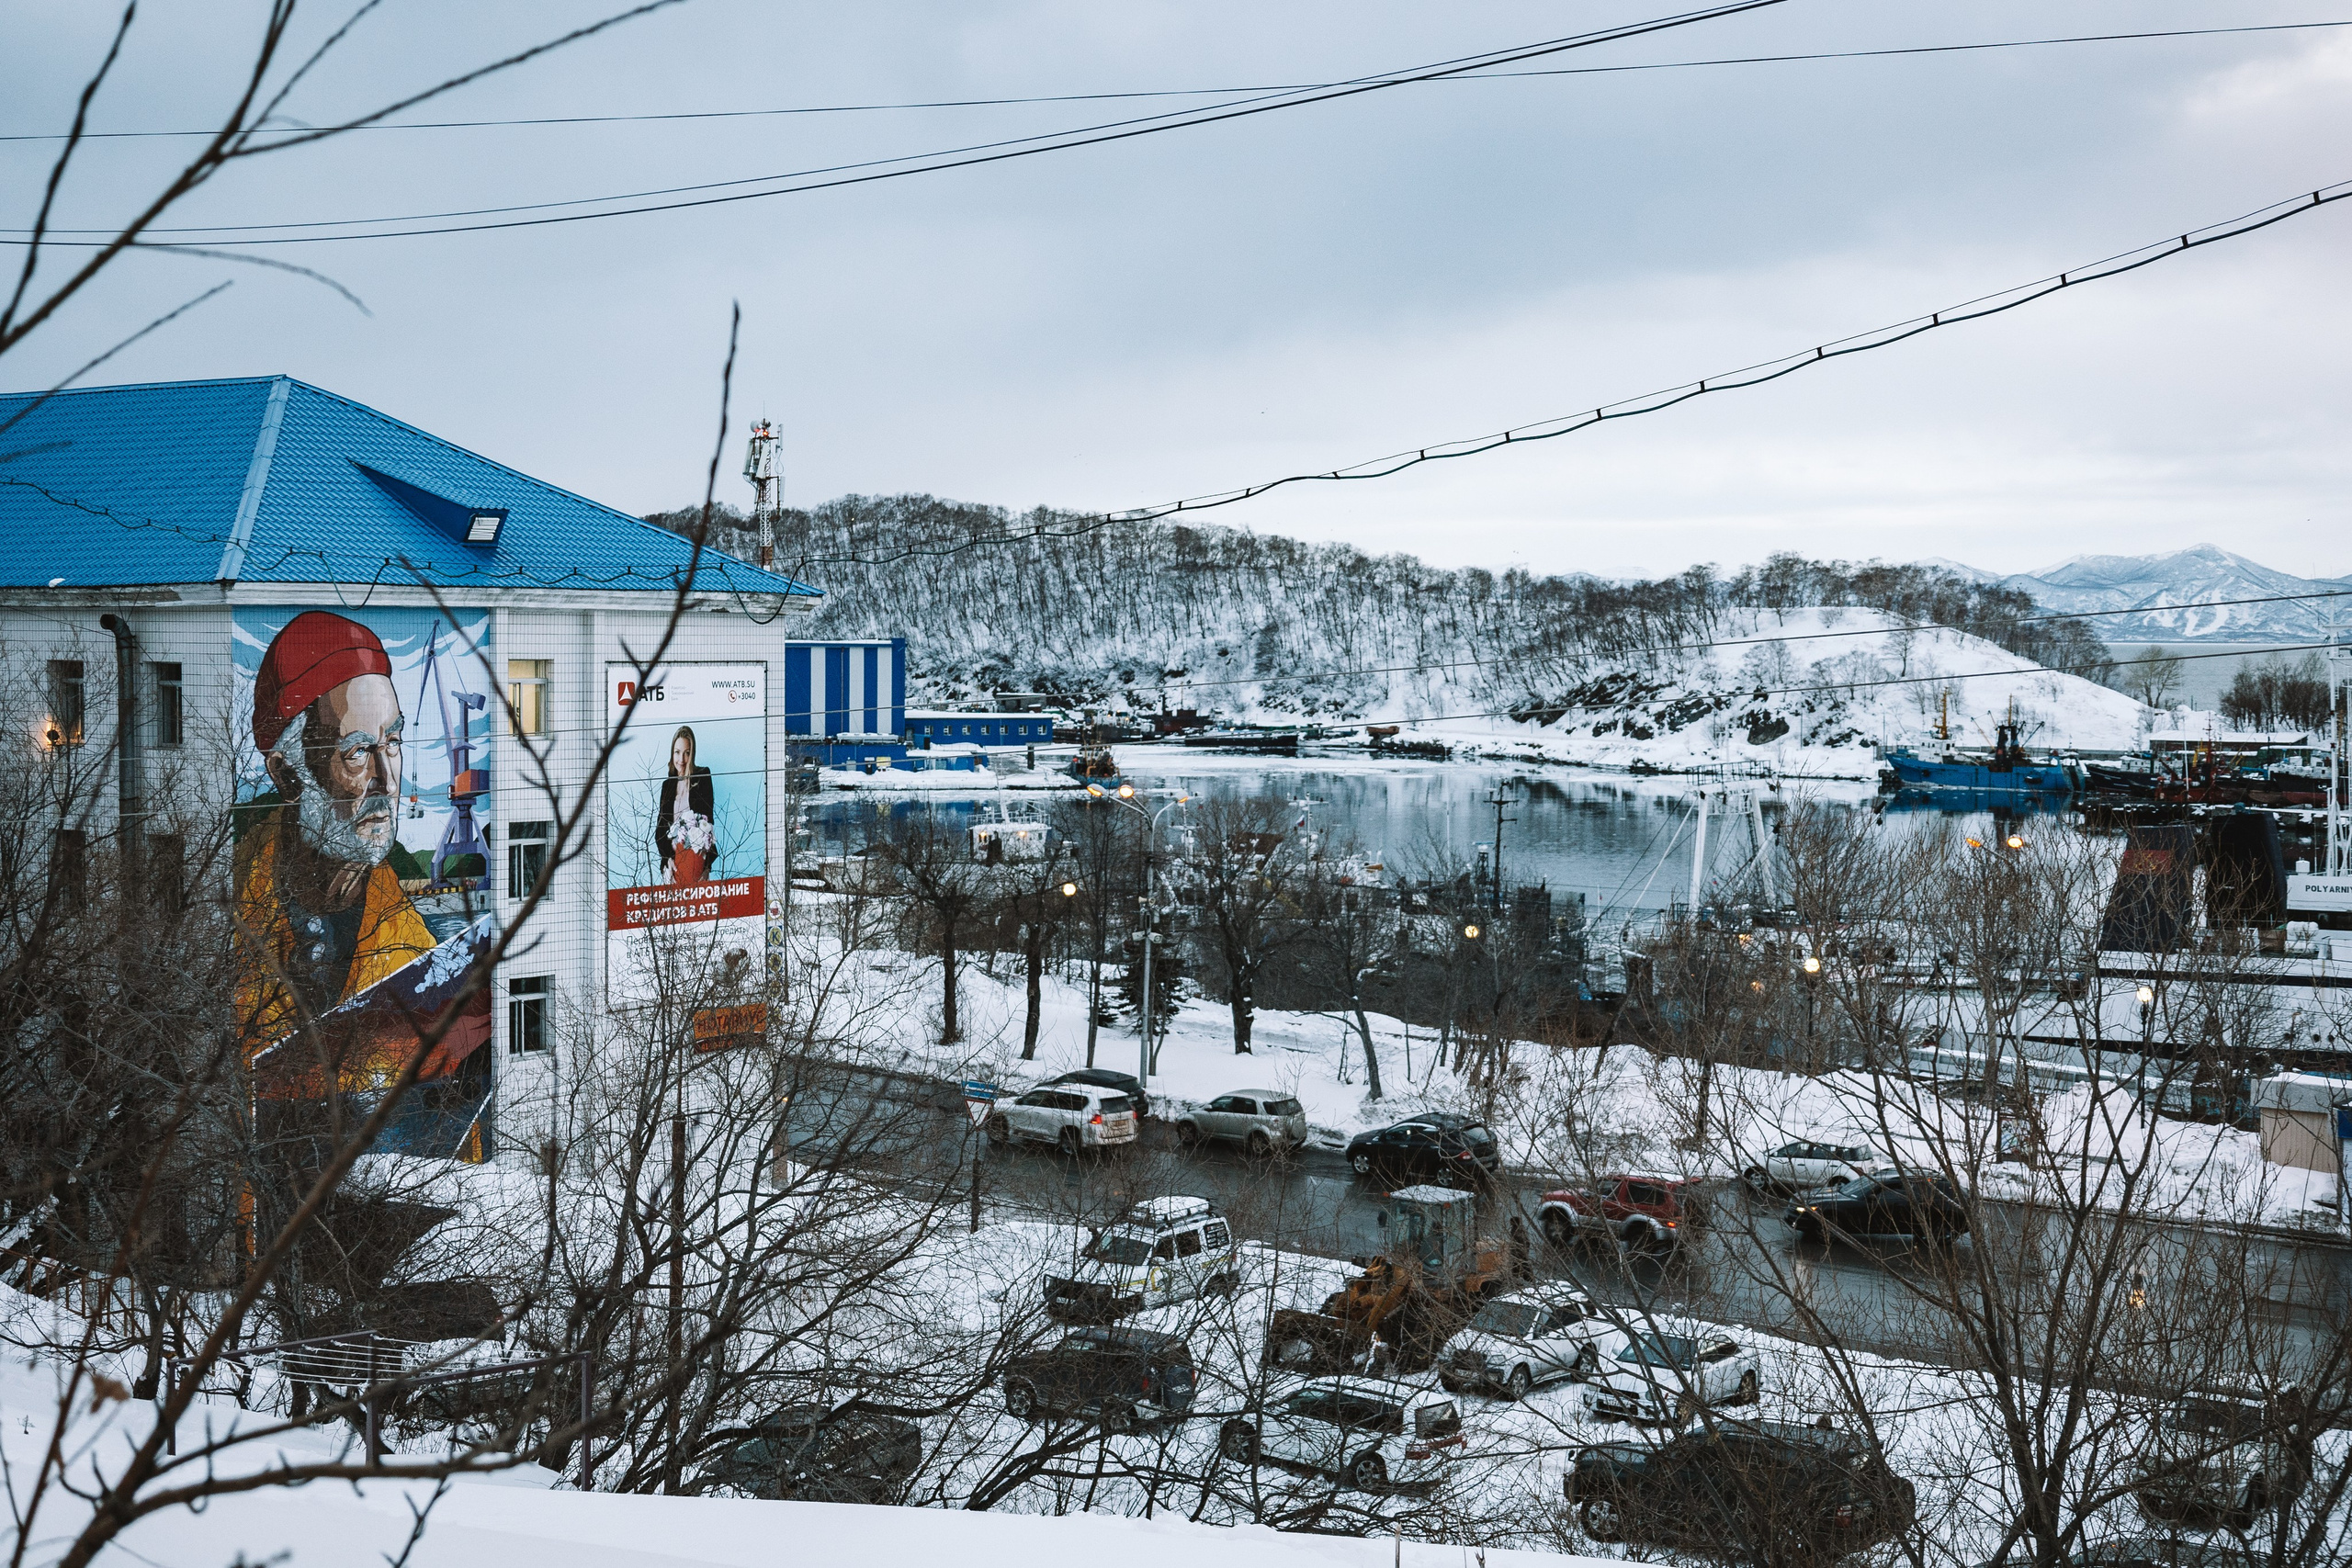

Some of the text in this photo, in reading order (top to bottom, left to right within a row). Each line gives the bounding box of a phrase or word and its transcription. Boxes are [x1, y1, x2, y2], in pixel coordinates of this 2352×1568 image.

[638, 685, 664, 701] АТБ
[711, 680, 755, 688] WWW.ATB.SU
[627, 883, 750, 906] РЕФИНАНСИРОВАНИЕ
[627, 903, 718, 923] КРЕДИТОВ В АТБ
